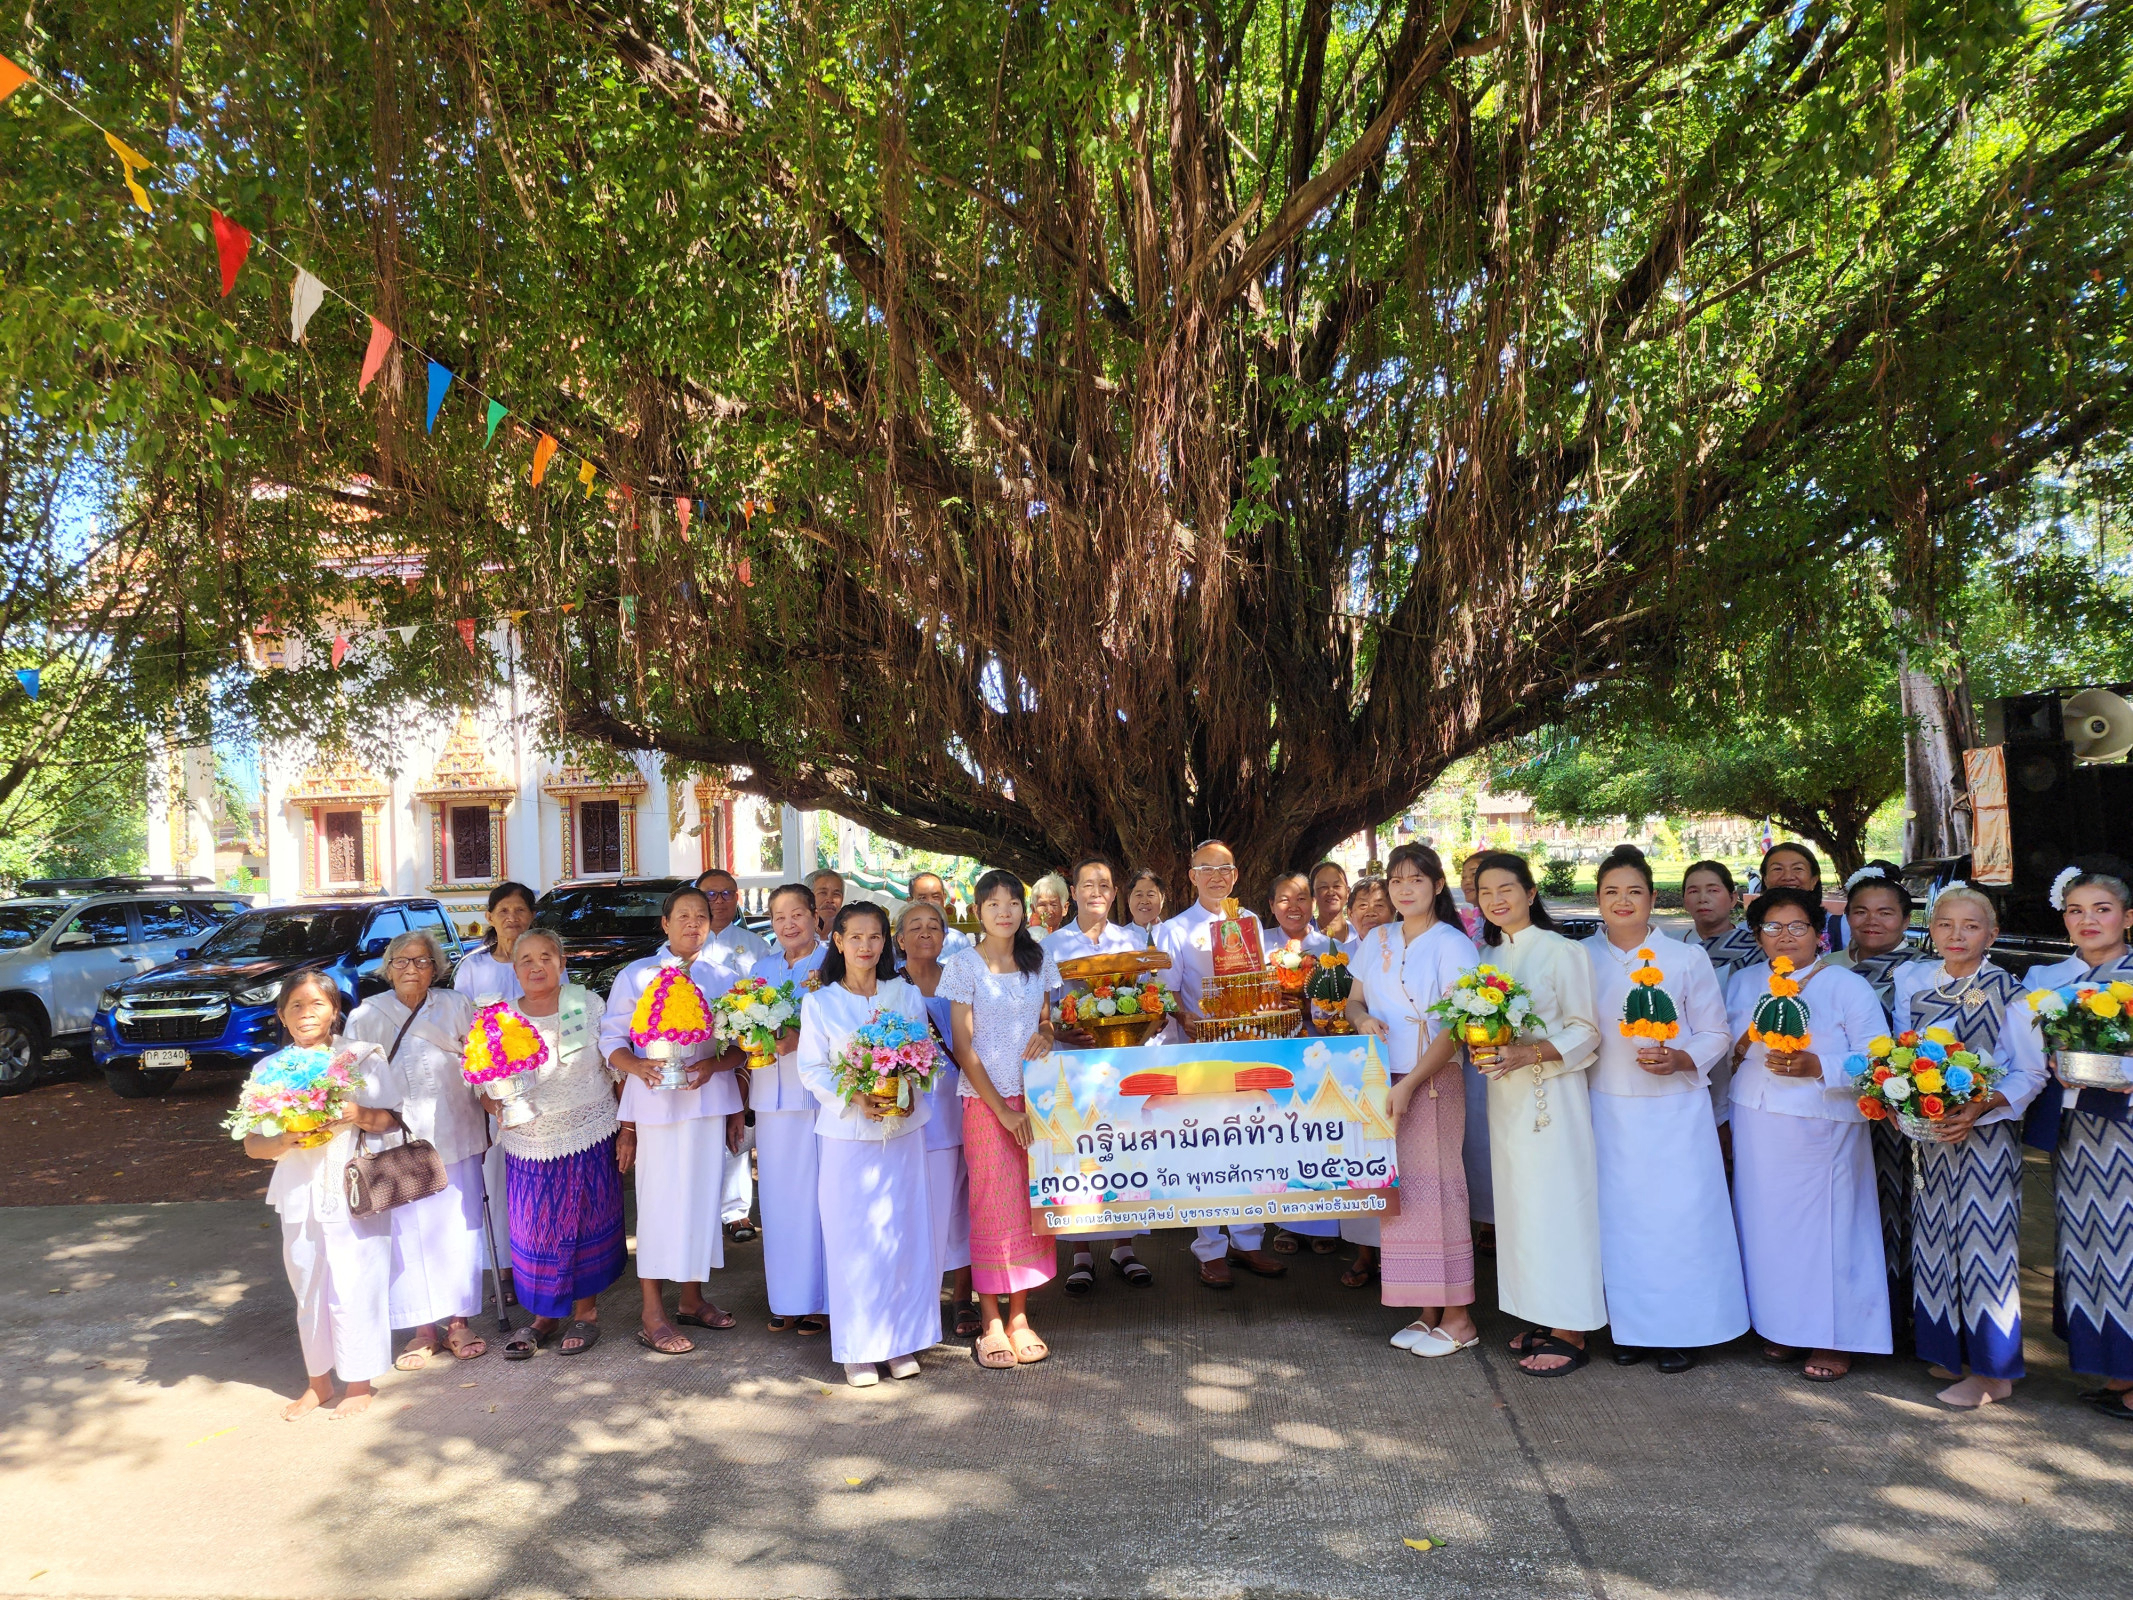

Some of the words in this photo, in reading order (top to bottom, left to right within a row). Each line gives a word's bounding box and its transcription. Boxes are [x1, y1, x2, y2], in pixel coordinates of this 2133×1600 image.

[150, 990, 191, 999] ISUZU
[162, 1050, 184, 1060] 2340
[1075, 1105, 1345, 1163] กฐินสามัคคีทั่วไทย
[1041, 1171, 1149, 1196] ๓๐,๐๐๐
[1156, 1167, 1180, 1187] วัด
[1186, 1163, 1289, 1193] พุทธศักราช
[1296, 1155, 1388, 1180] ๒๕๖๘
[1046, 1213, 1071, 1227] โดย
[1179, 1207, 1240, 1224] บูชาธรรม
[1244, 1205, 1263, 1216] ๘๑
[1267, 1200, 1277, 1214] ปี
[1281, 1196, 1386, 1213] หลวงพ่อธัมมชโย
